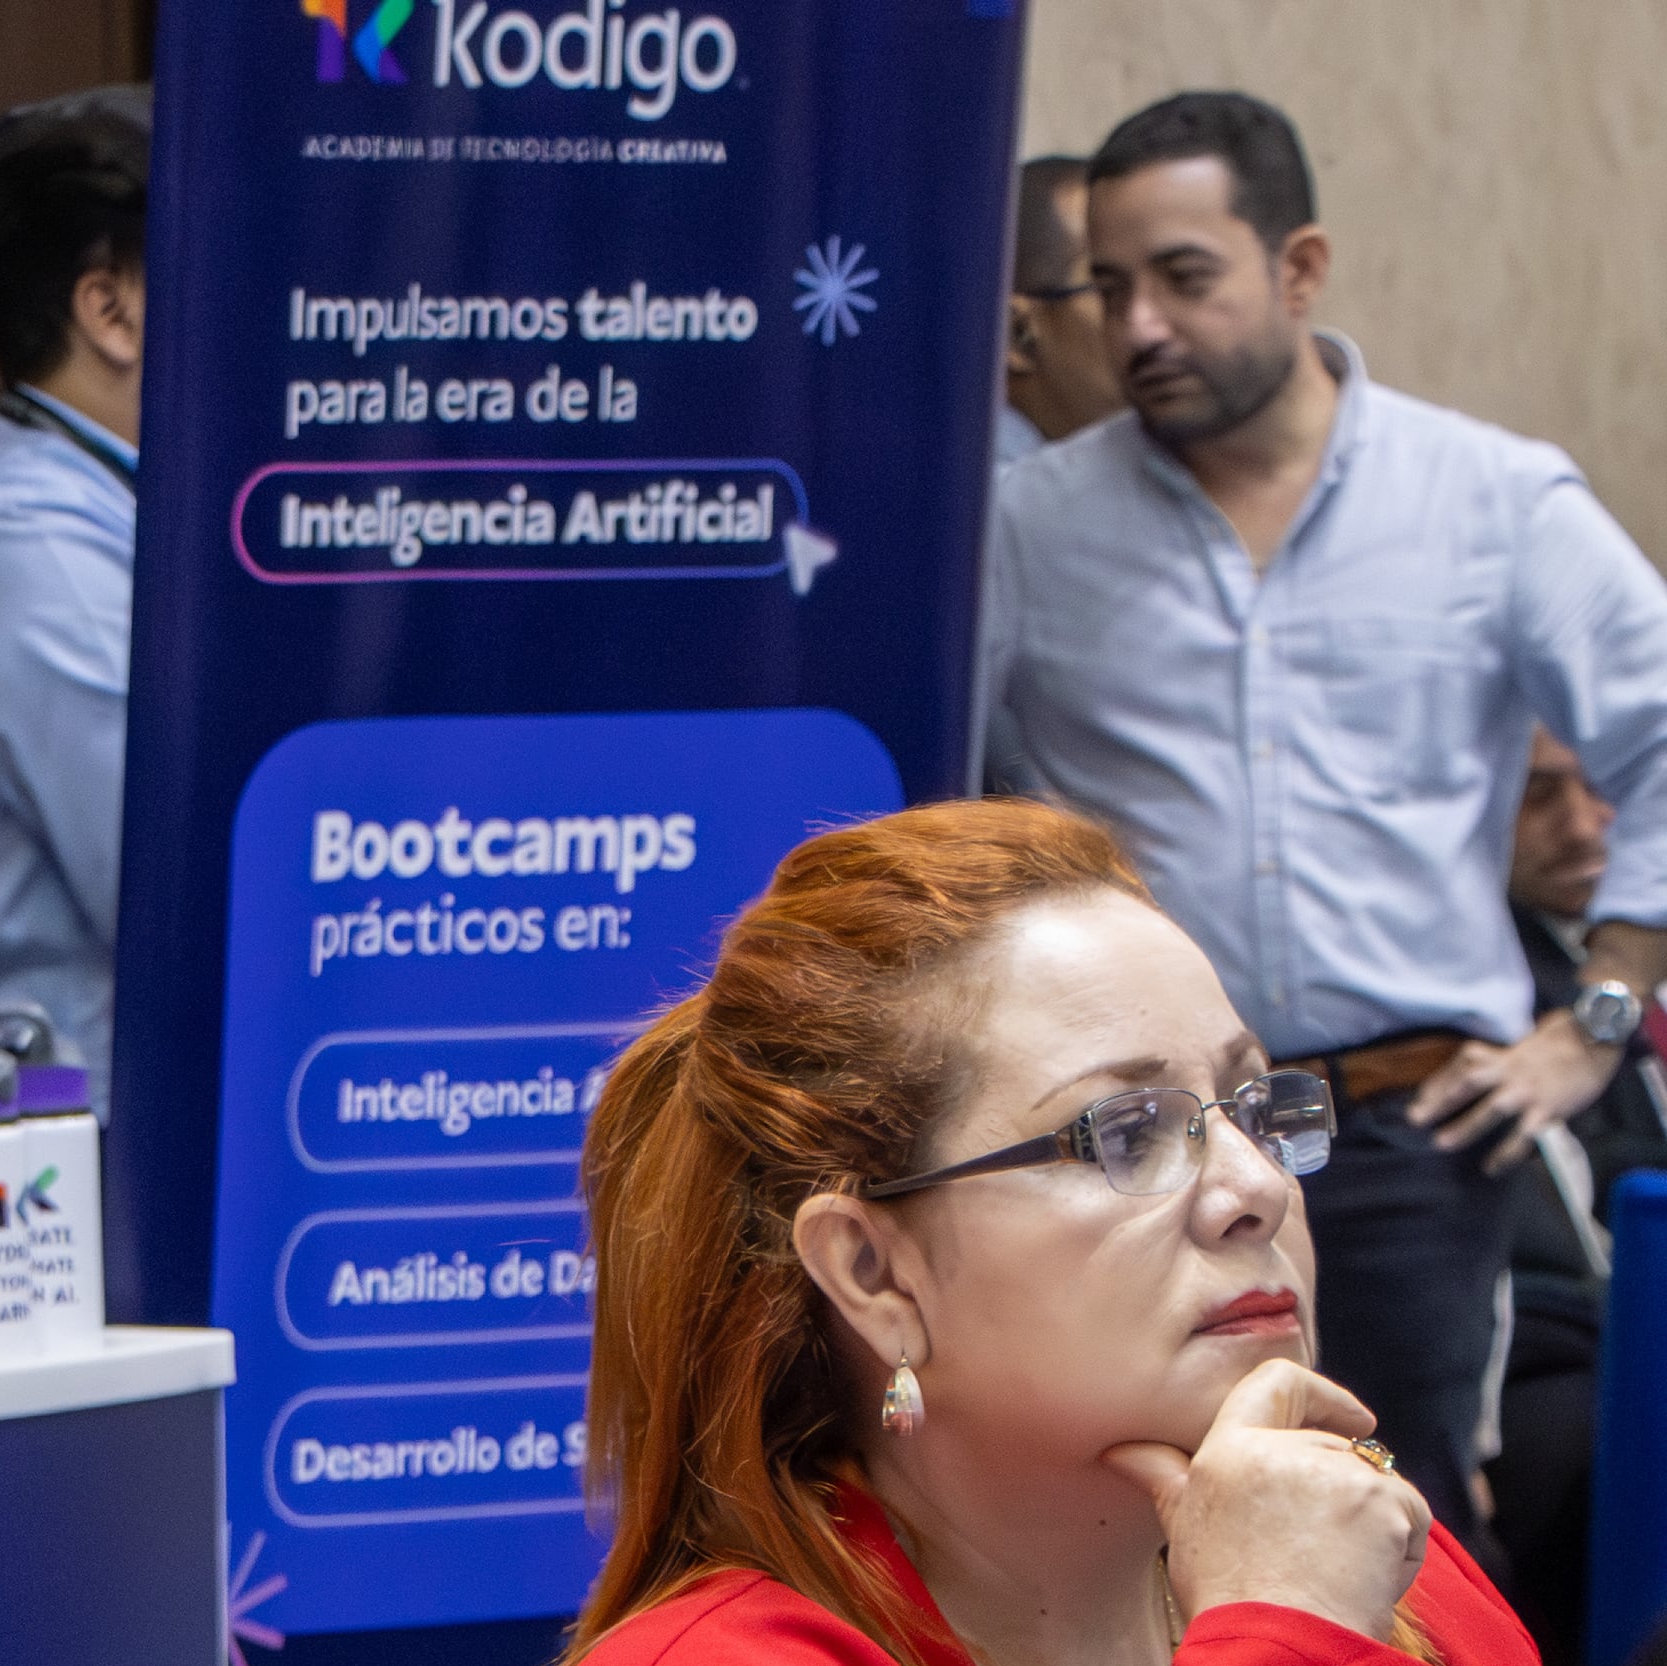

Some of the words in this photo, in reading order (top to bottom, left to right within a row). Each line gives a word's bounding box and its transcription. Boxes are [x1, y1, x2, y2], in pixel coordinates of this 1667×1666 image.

[302, 135, 425, 162] ACADEMIA
[617, 138, 728, 164] CREATIVA
[287, 283, 568, 357] Impulsamos
[575, 281, 759, 343] talento
[283, 377, 386, 439] para
[392, 366, 429, 423] la
[434, 377, 515, 423] era
[525, 365, 590, 423] de
[598, 365, 638, 423] la
[279, 486, 556, 567] Inteligencia
[562, 481, 774, 546] Artificial
[312, 806, 697, 894] Bootcamps
[310, 893, 546, 977] prácticos
[553, 904, 632, 950] en:
[336, 1066, 575, 1137] Inteligencia
[327, 1249, 485, 1307] Análisis
[493, 1248, 543, 1299] de
[292, 1428, 500, 1485] Desarrollo
[506, 1421, 558, 1470] de
